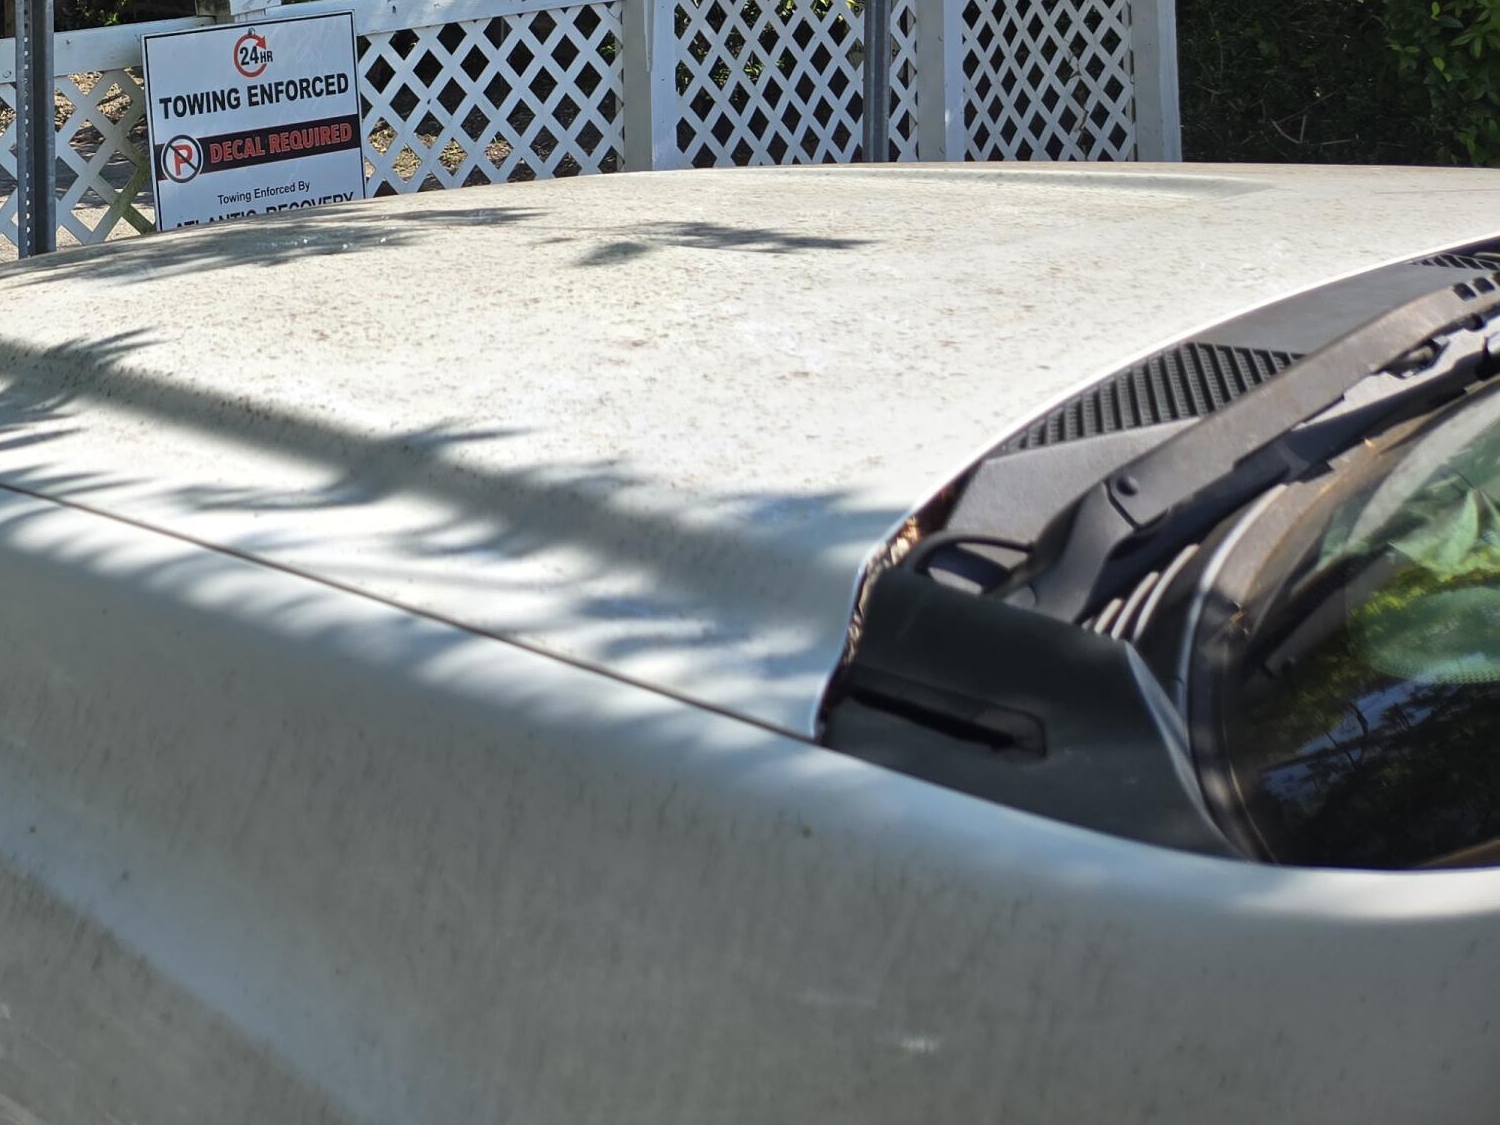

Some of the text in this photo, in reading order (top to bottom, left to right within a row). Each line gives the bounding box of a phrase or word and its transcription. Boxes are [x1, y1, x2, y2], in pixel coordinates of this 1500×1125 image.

[159, 72, 349, 119] TOWING ENFORCED
[210, 122, 352, 164] DECAL REQUIRED
[217, 180, 310, 205] Towing Enforced By
